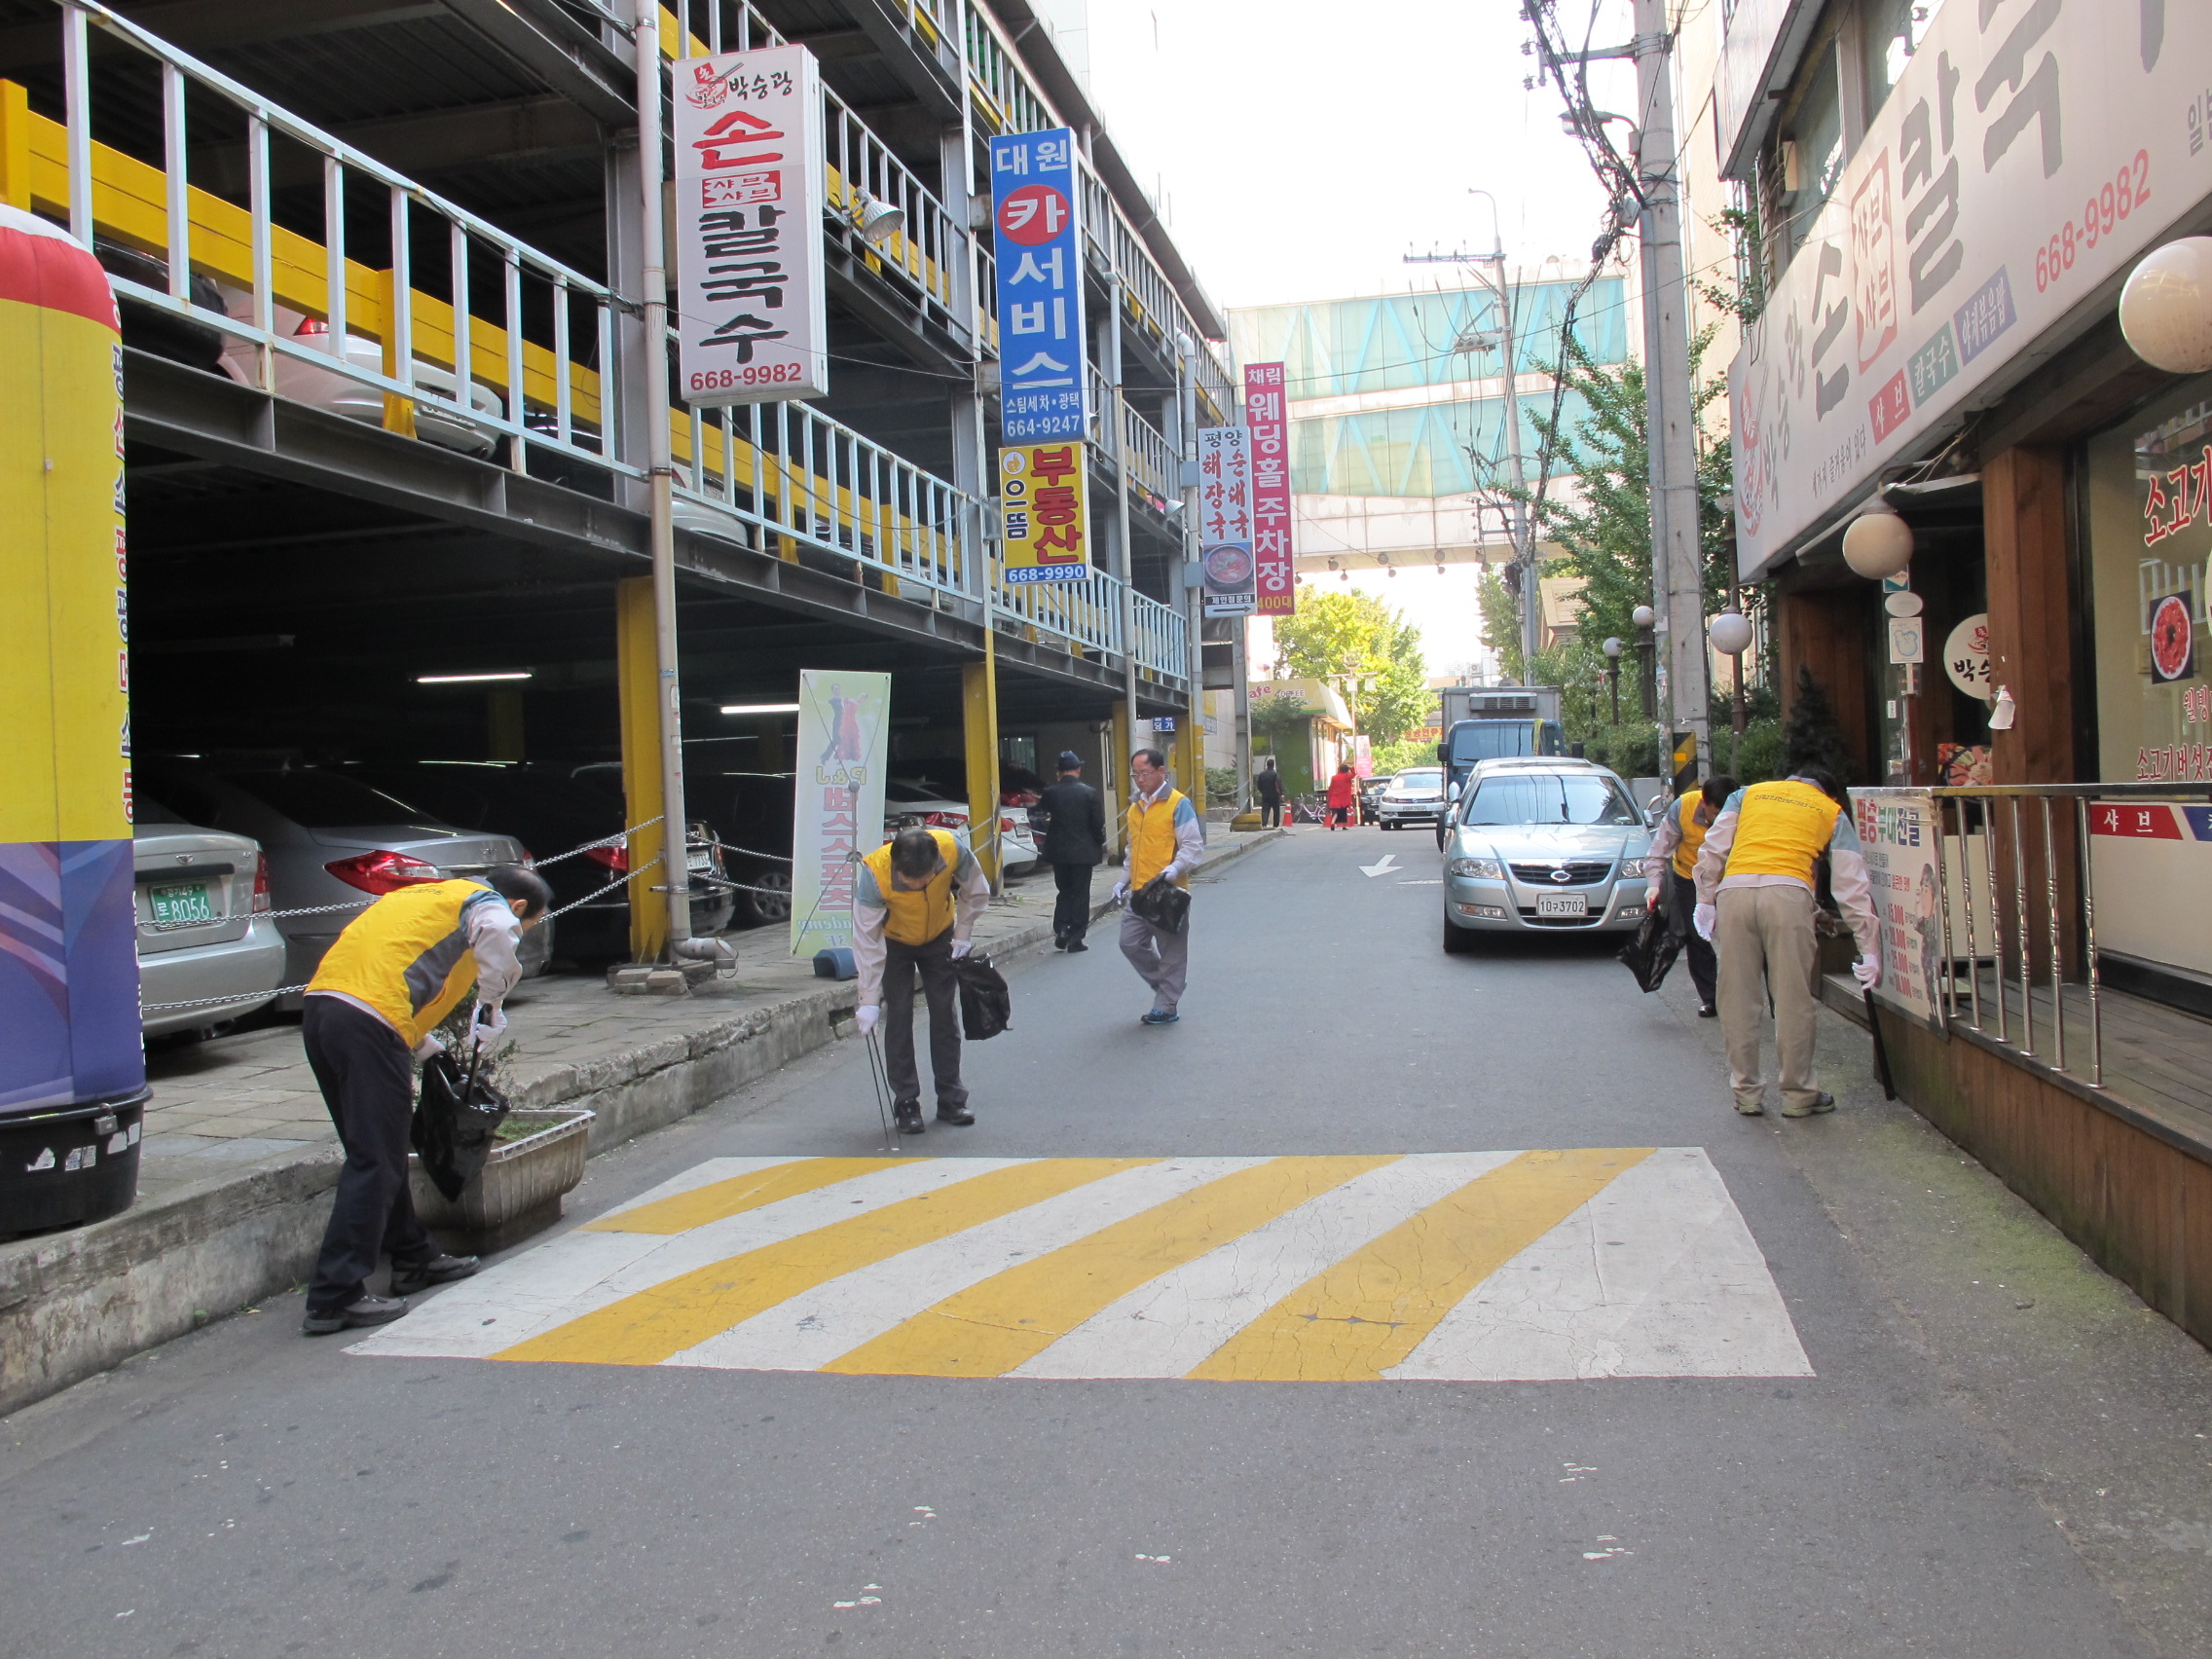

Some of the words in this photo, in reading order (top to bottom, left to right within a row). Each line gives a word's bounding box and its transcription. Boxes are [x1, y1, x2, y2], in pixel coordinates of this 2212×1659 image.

[728, 69, 793, 101] 박승광
[692, 110, 785, 170] 손
[996, 139, 1070, 175] 대원
[713, 176, 766, 190] 샤브
[721, 189, 771, 202] 샤브
[2036, 149, 2151, 293] 668-9982
[699, 204, 789, 364] 칼국수
[1007, 194, 1074, 389] 카서비스
[1812, 240, 1850, 422] 손
[690, 362, 802, 391] 668-9982
[1248, 367, 1281, 386] 채림
[1914, 334, 1951, 398] 칼국수
[1007, 415, 1081, 437] 664-9247
[1204, 429, 1243, 448] 평양
[1249, 391, 1285, 489] 웨딩홀
[1005, 479, 1029, 540] 으뜸
[1030, 446, 1083, 566] 부동산
[1201, 450, 1227, 540] 해장국
[1226, 448, 1250, 539] 순대국
[2144, 445, 2212, 547] 소고기
[1256, 497, 1291, 591] 주차장
[1009, 565, 1085, 582] 668-9990
[1954, 658, 1991, 683] 박승
[1249, 683, 1272, 698] afé
[2184, 684, 2212, 722] 웰빙
[171, 896, 210, 921] 8056
[1540, 901, 1585, 913] 10구3702
